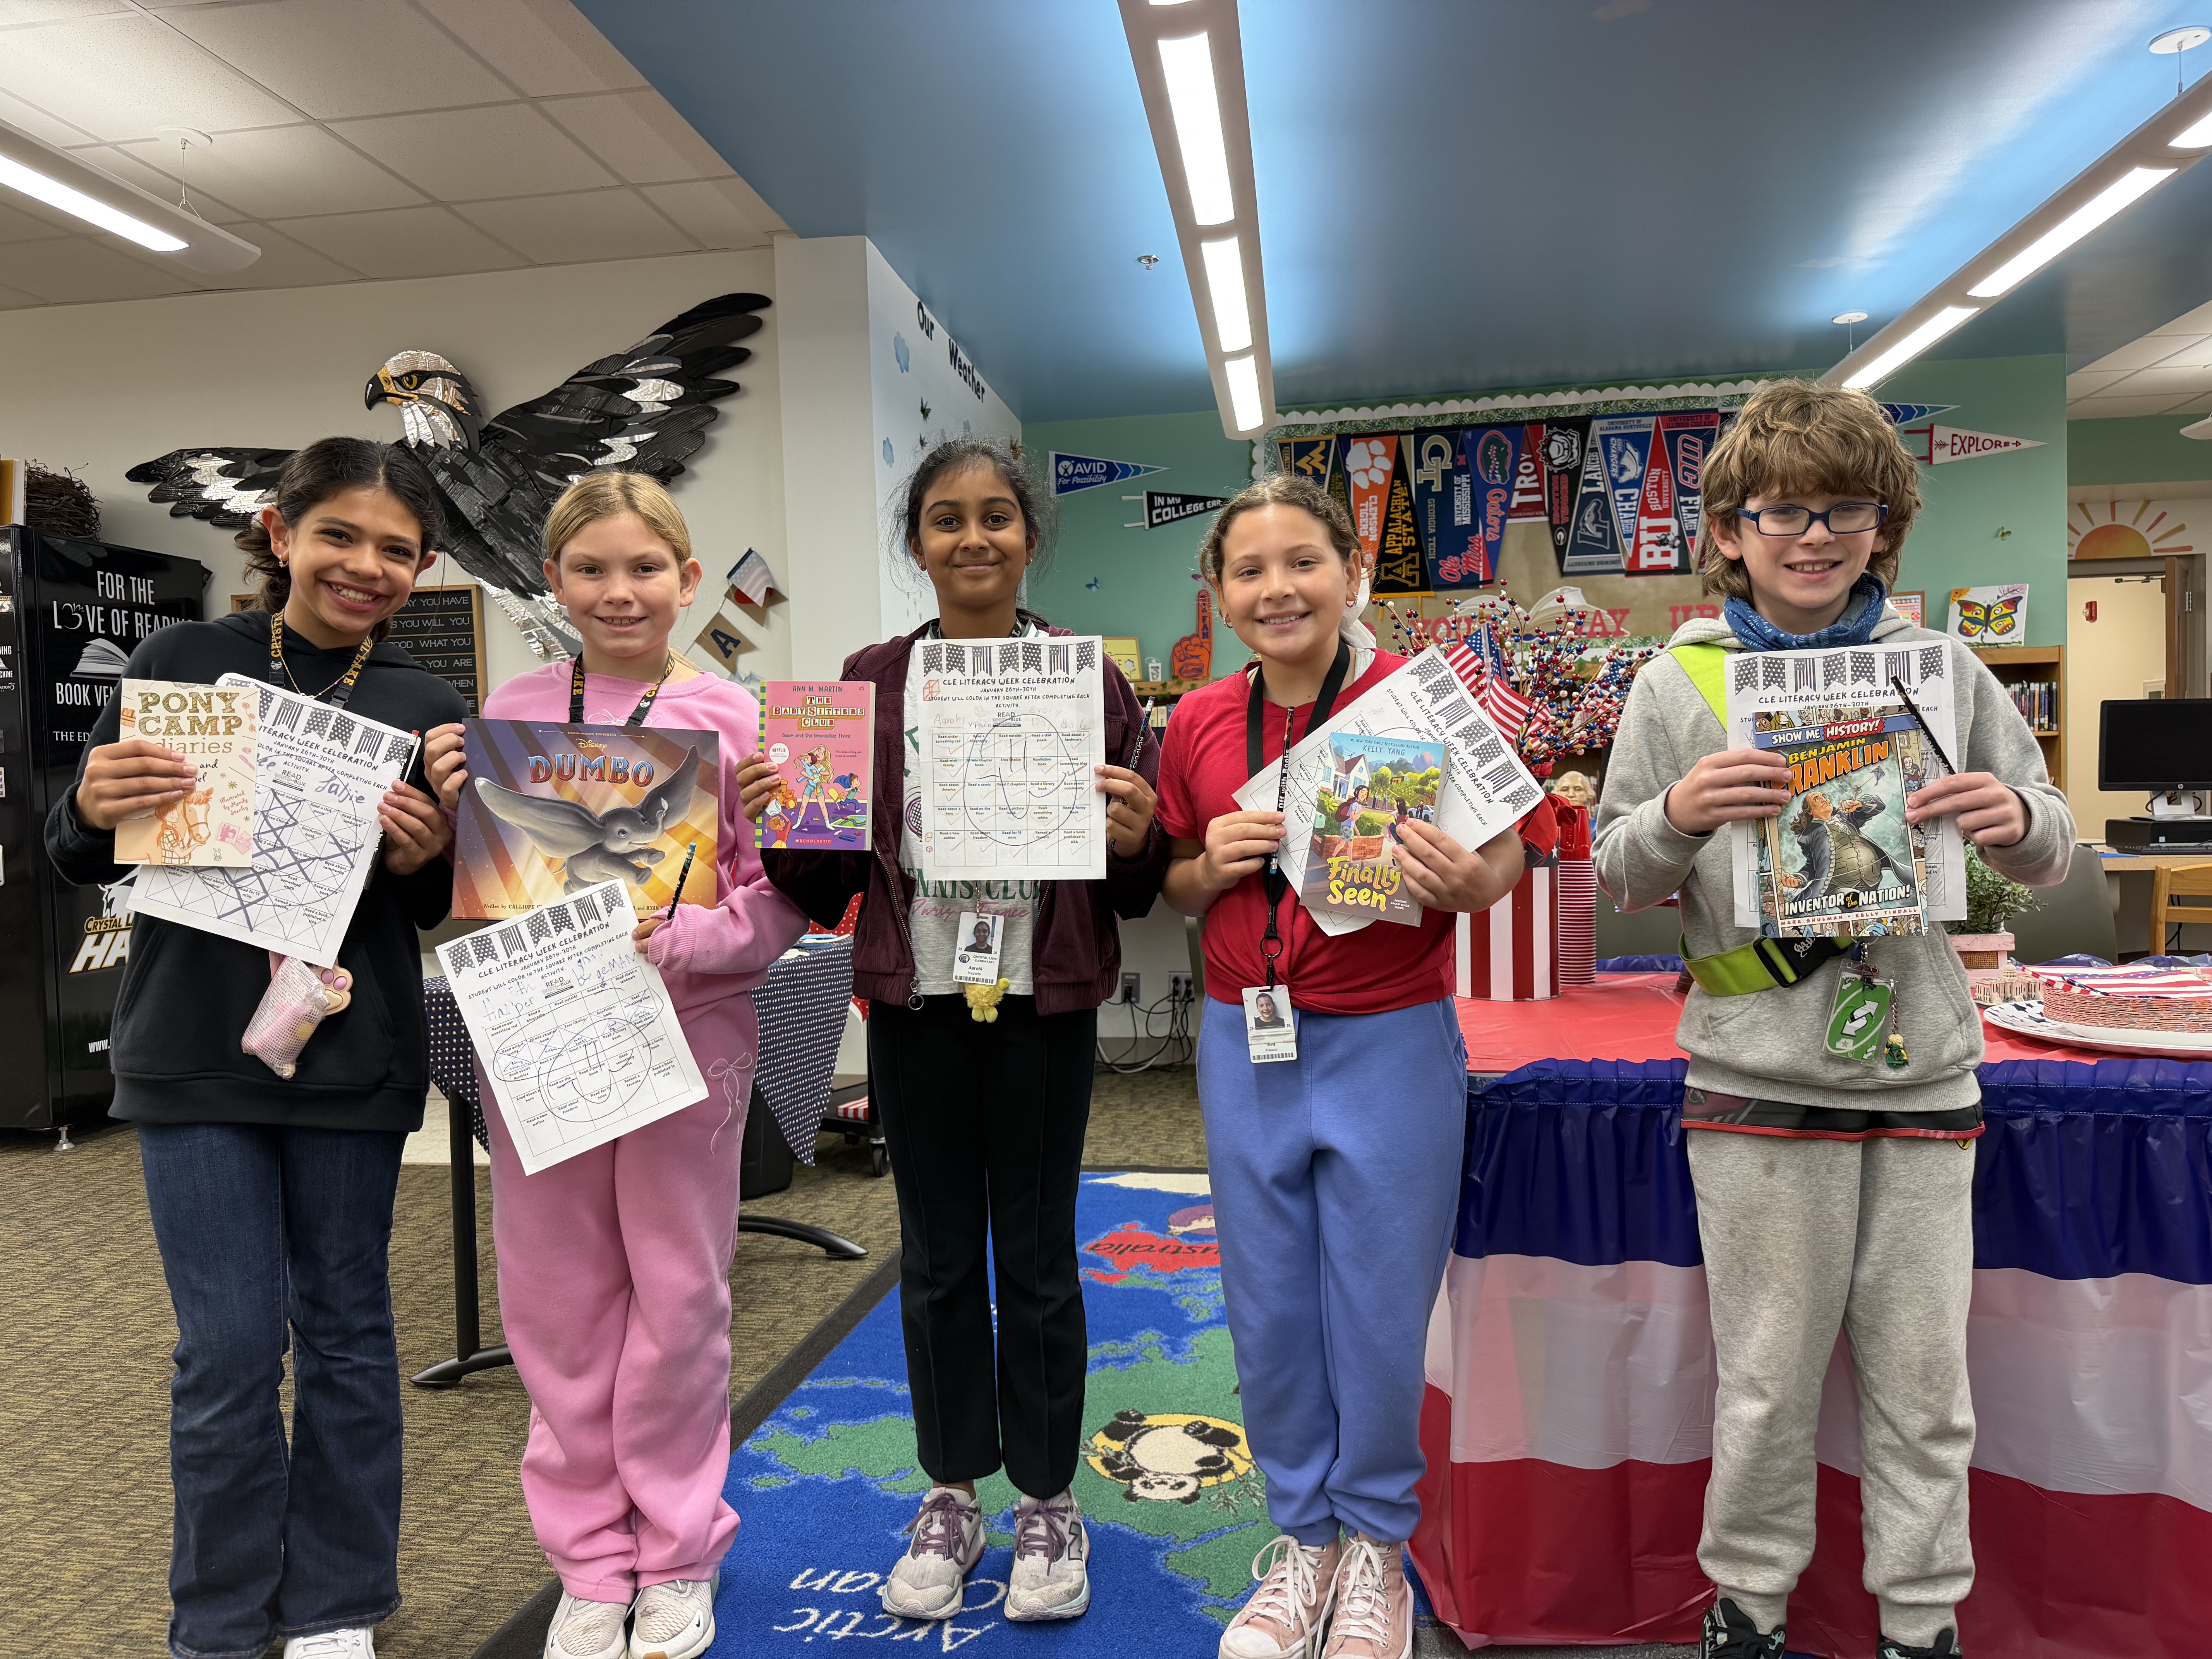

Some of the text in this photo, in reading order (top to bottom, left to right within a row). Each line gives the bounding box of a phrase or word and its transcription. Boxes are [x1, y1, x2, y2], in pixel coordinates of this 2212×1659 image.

[917, 301, 934, 341] Our
[948, 338, 985, 403] Weather
[1610, 437, 1619, 479] CHARGERS
[1951, 434, 2010, 456] EXPLORE
[1074, 462, 1107, 474] AVID
[1581, 451, 1606, 495] LANCERS
[1677, 434, 1702, 489] UIC
[1072, 474, 1107, 484] Possibility
[1511, 453, 1543, 508] TROY
[1646, 468, 1662, 511] BOSTON
[1152, 500, 1221, 524] COLLEGE ERA
[1154, 496, 1164, 507] IN
[1454, 475, 1462, 526] UNIVERSITY OF
[1462, 474, 1471, 525] MISSISSIPPI
[1360, 501, 1369, 537] TIGERS
[1369, 495, 1377, 541] CLEMSON
[1385, 479, 1403, 555] APPALACHIAN
[1402, 483, 1416, 546] STATE
[1427, 498, 1436, 534] GEORGIA
[1486, 488, 1507, 541] Gators
[1614, 488, 1639, 539] CHARGERS
[1639, 516, 1679, 568] BU
[1439, 555, 1461, 582] Ole
[97, 571, 155, 605] FOR THE
[420, 596, 469, 606] YOU HAVE
[112, 609, 128, 637] OF
[399, 617, 470, 628] YOU WILL YOU
[419, 638, 471, 647] WHAT YOU
[710, 629, 741, 659] A
[426, 660, 447, 668] YOU
[453, 659, 473, 667] ARE
[56, 682, 91, 706] BOOK
[573, 666, 584, 696] LAKE
[960, 678, 996, 686] LITERACY
[1022, 677, 1075, 685] CELEBRATION
[138, 692, 240, 714] PONY
[807, 696, 831, 705] THE
[1779, 694, 1820, 703] LITERACY
[1824, 692, 1847, 701] WEEK
[803, 718, 835, 727] CLUB
[809, 707, 864, 716] SITTERS
[933, 714, 965, 726] Aarohi
[53, 731, 74, 741] THE
[138, 716, 242, 736] CAMP
[1772, 720, 1880, 745] SHOW ME HISTORY!
[273, 740, 335, 764] JANUARY 26TH-30TH
[297, 738, 379, 771] WEEK CELEBRATION
[1363, 745, 1405, 756] KELLY YANG
[1386, 688, 1488, 826] STUDENT COMPLETING EACH
[1410, 691, 1495, 804] CLE LITERACY WEEK CELEBRATION
[1788, 737, 1865, 764] BENJAMIN
[200, 759, 218, 769] and
[527, 754, 654, 787] DUMBO
[1774, 740, 1889, 797] RANKLIN
[337, 770, 388, 790] COMPLETING EACH
[219, 791, 245, 804] Illustrated
[230, 806, 249, 816] Stanley
[231, 798, 248, 809] Mandy
[1326, 856, 1401, 895] Finally
[1326, 880, 1387, 912] Seen
[1784, 884, 1910, 916] INVENTOR of the NATION!
[84, 916, 122, 933] CRYSTAL
[479, 921, 610, 978] CLE LITERACY WEEK CELEBRATION
[520, 945, 577, 971] JANUARY 26TH-30TH
[469, 931, 628, 1000] STUDENT WILL COLOR COMPLETING EACH
[541, 967, 566, 980] ACTIVITY.
[654, 1067, 671, 1077] published
[1090, 1243, 1219, 1255] ustralia
[773, 1608, 999, 1652] Arctic
